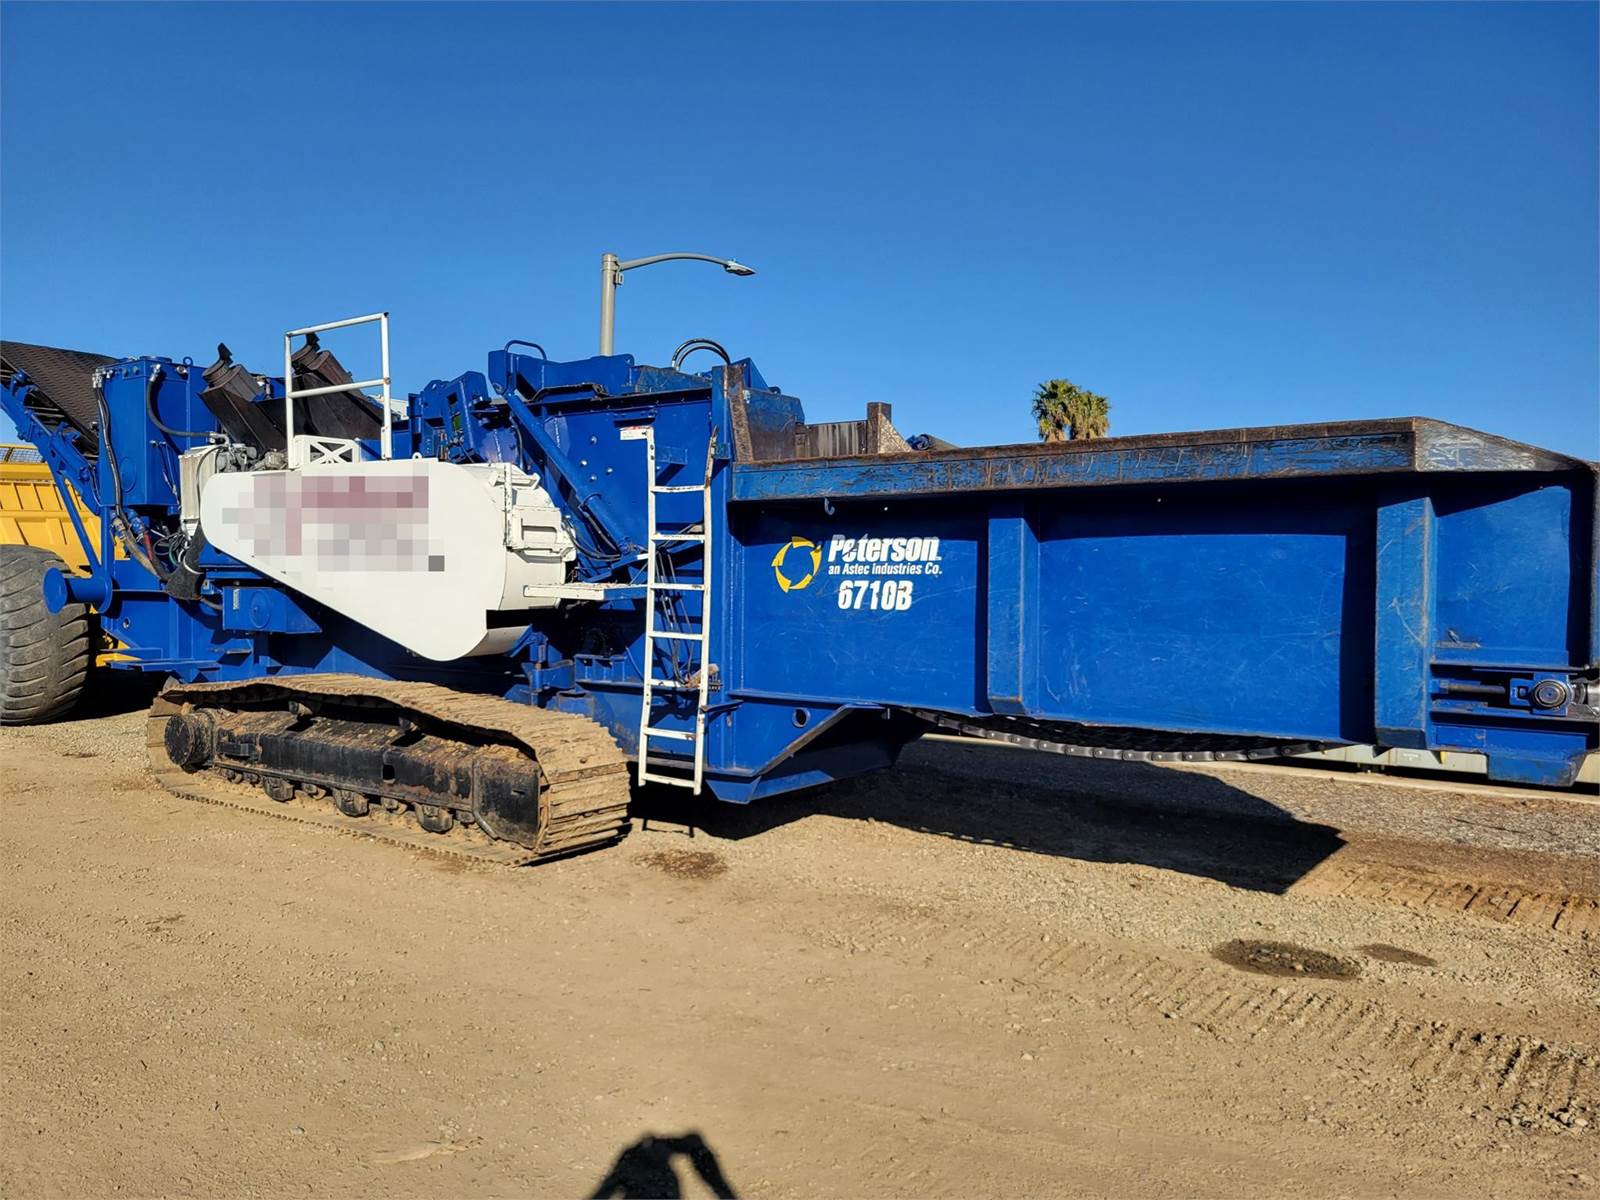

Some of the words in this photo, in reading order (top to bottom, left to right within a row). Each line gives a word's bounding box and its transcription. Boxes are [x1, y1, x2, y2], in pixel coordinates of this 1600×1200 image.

[828, 565, 840, 575] an
[842, 563, 870, 575] Astec
[925, 562, 943, 575] Co.
[838, 580, 913, 610] 6710B
